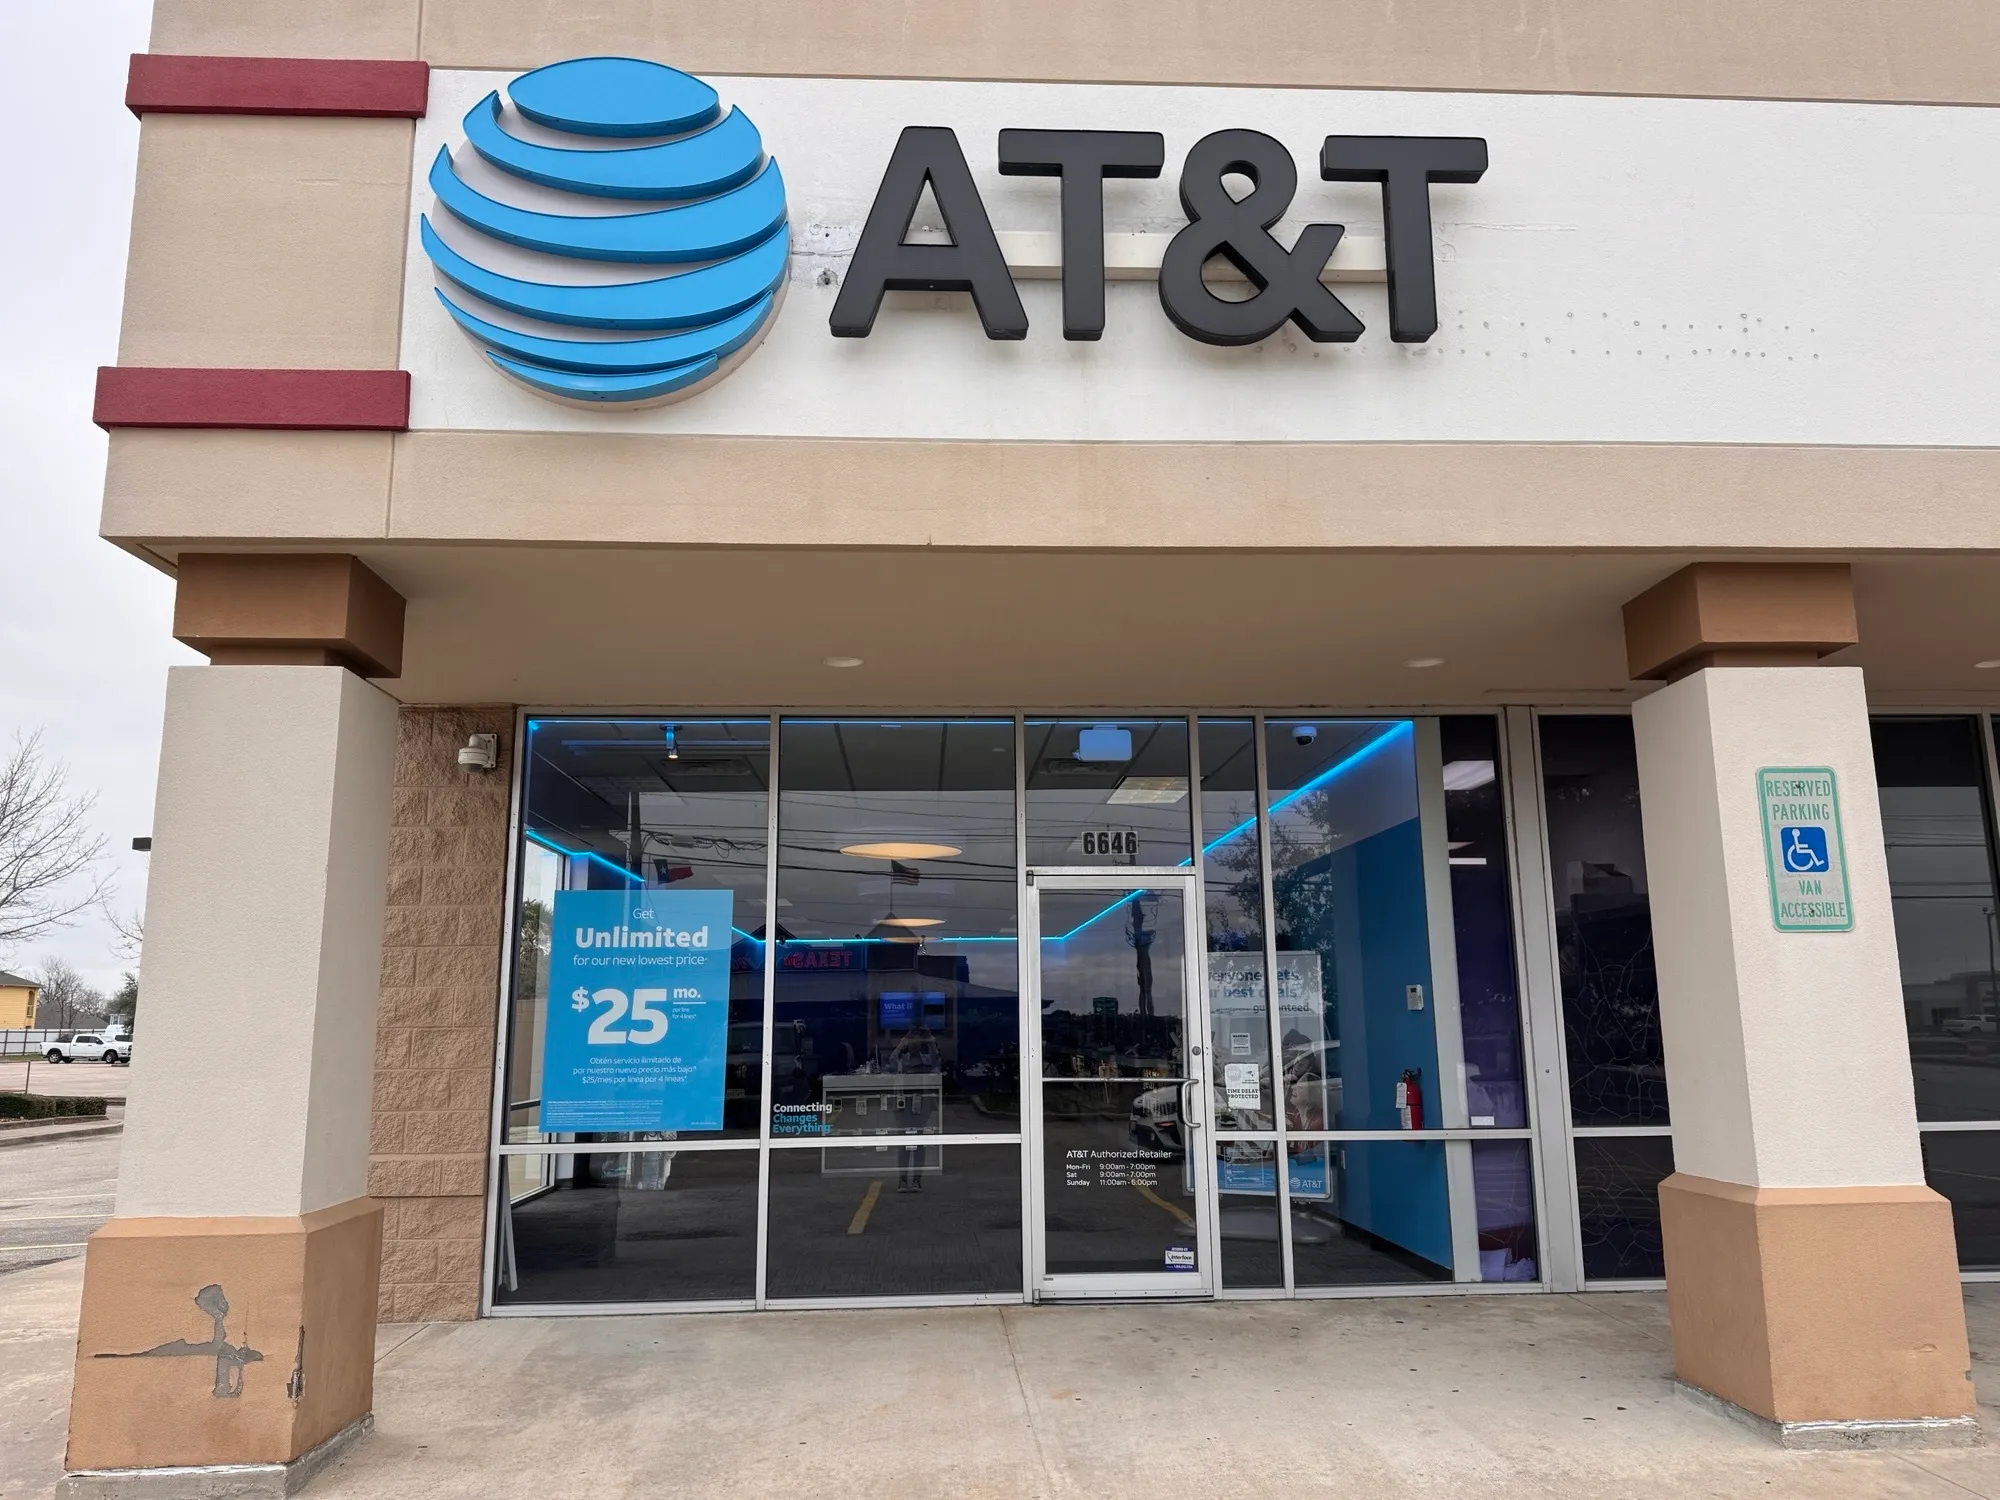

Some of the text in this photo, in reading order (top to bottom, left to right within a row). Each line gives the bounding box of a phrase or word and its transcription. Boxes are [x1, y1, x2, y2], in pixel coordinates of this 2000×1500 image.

[829, 126, 1490, 347] AT&T
[1766, 780, 1831, 797] RESERVED
[1772, 803, 1830, 821] PARKING
[1083, 832, 1138, 855] 6646
[1798, 880, 1823, 895] VAN
[632, 907, 655, 920] Get
[1780, 901, 1847, 918] ACCESSIBLE
[575, 925, 709, 949] Unlimited
[573, 954, 589, 966] for
[591, 956, 611, 967] our
[612, 956, 636, 967] new
[637, 954, 674, 966] lowest
[673, 987, 702, 999] mo.
[573, 1067, 586, 1075] por
[773, 1101, 833, 1114] Connecting
[773, 1113, 818, 1124] Changes
[772, 1123, 832, 1135] Everything
[1066, 1150, 1172, 1158] AT&T Authorized Retailer
[1130, 1171, 1156, 1179] 7:00pm
[1302, 1180, 1322, 1188] AT&T
